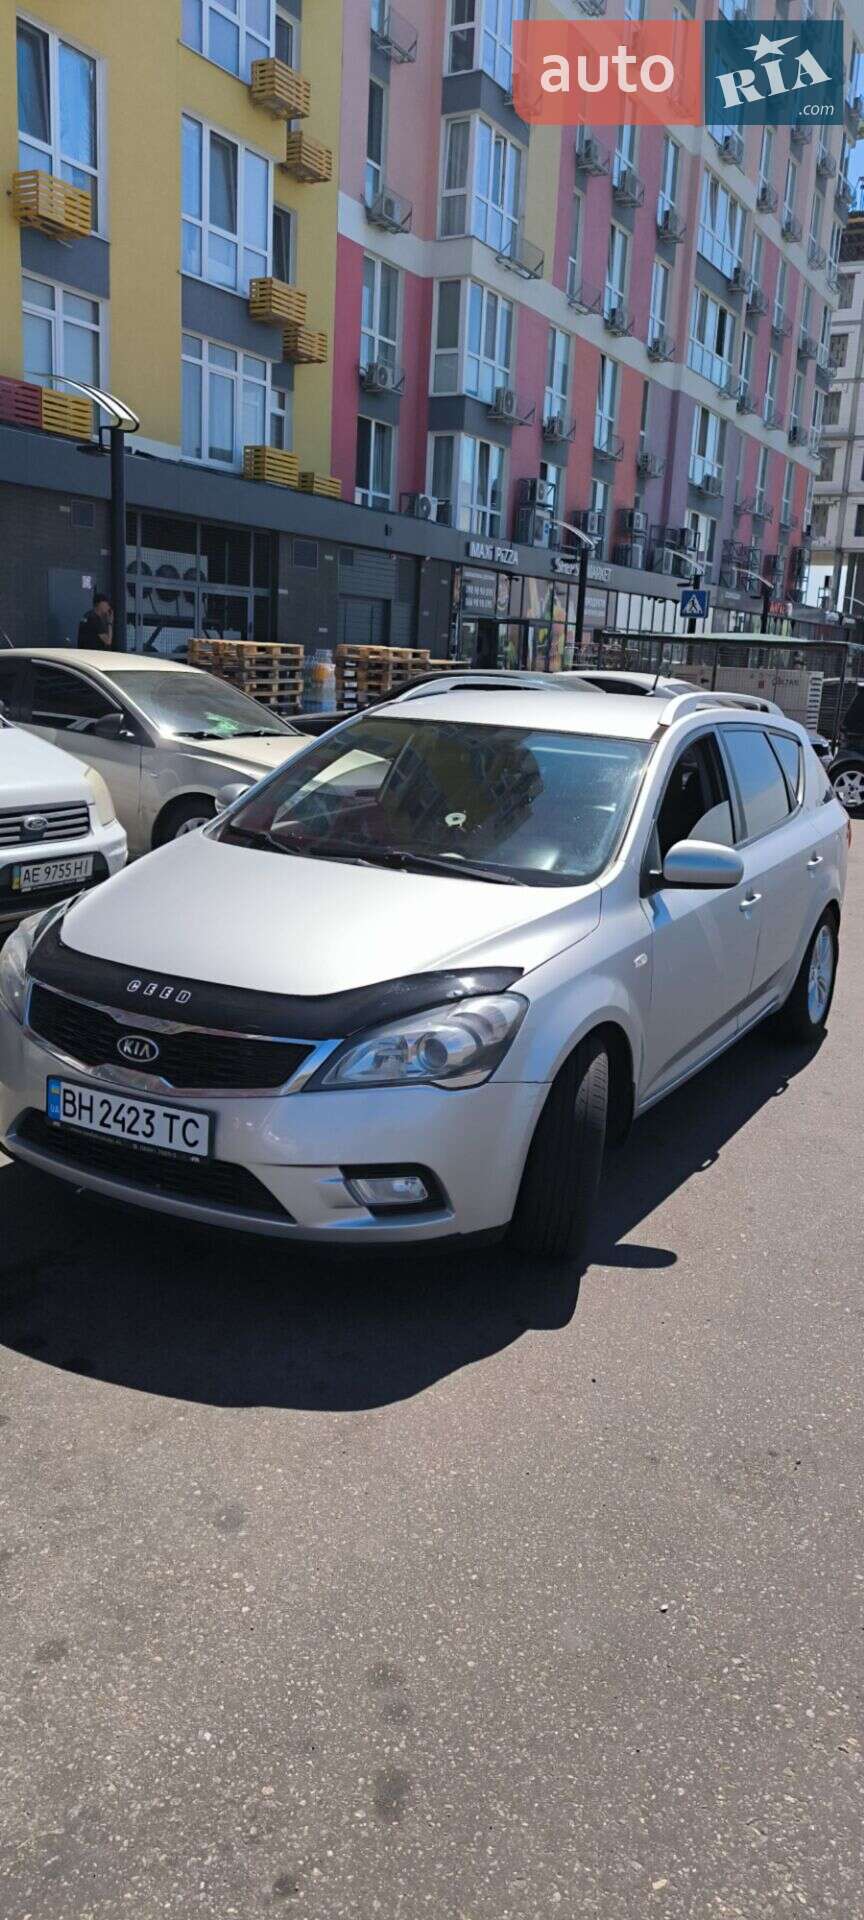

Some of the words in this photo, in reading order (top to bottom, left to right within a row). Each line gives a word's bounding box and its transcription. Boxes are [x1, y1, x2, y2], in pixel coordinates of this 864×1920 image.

[23, 867, 41, 883] AE
[44, 862, 71, 881] 9755
[126, 979, 192, 1004] CEED
[123, 1039, 151, 1059] KIA
[62, 1089, 94, 1124] BH
[99, 1099, 155, 1139] 2423
[163, 1112, 200, 1148] TC
